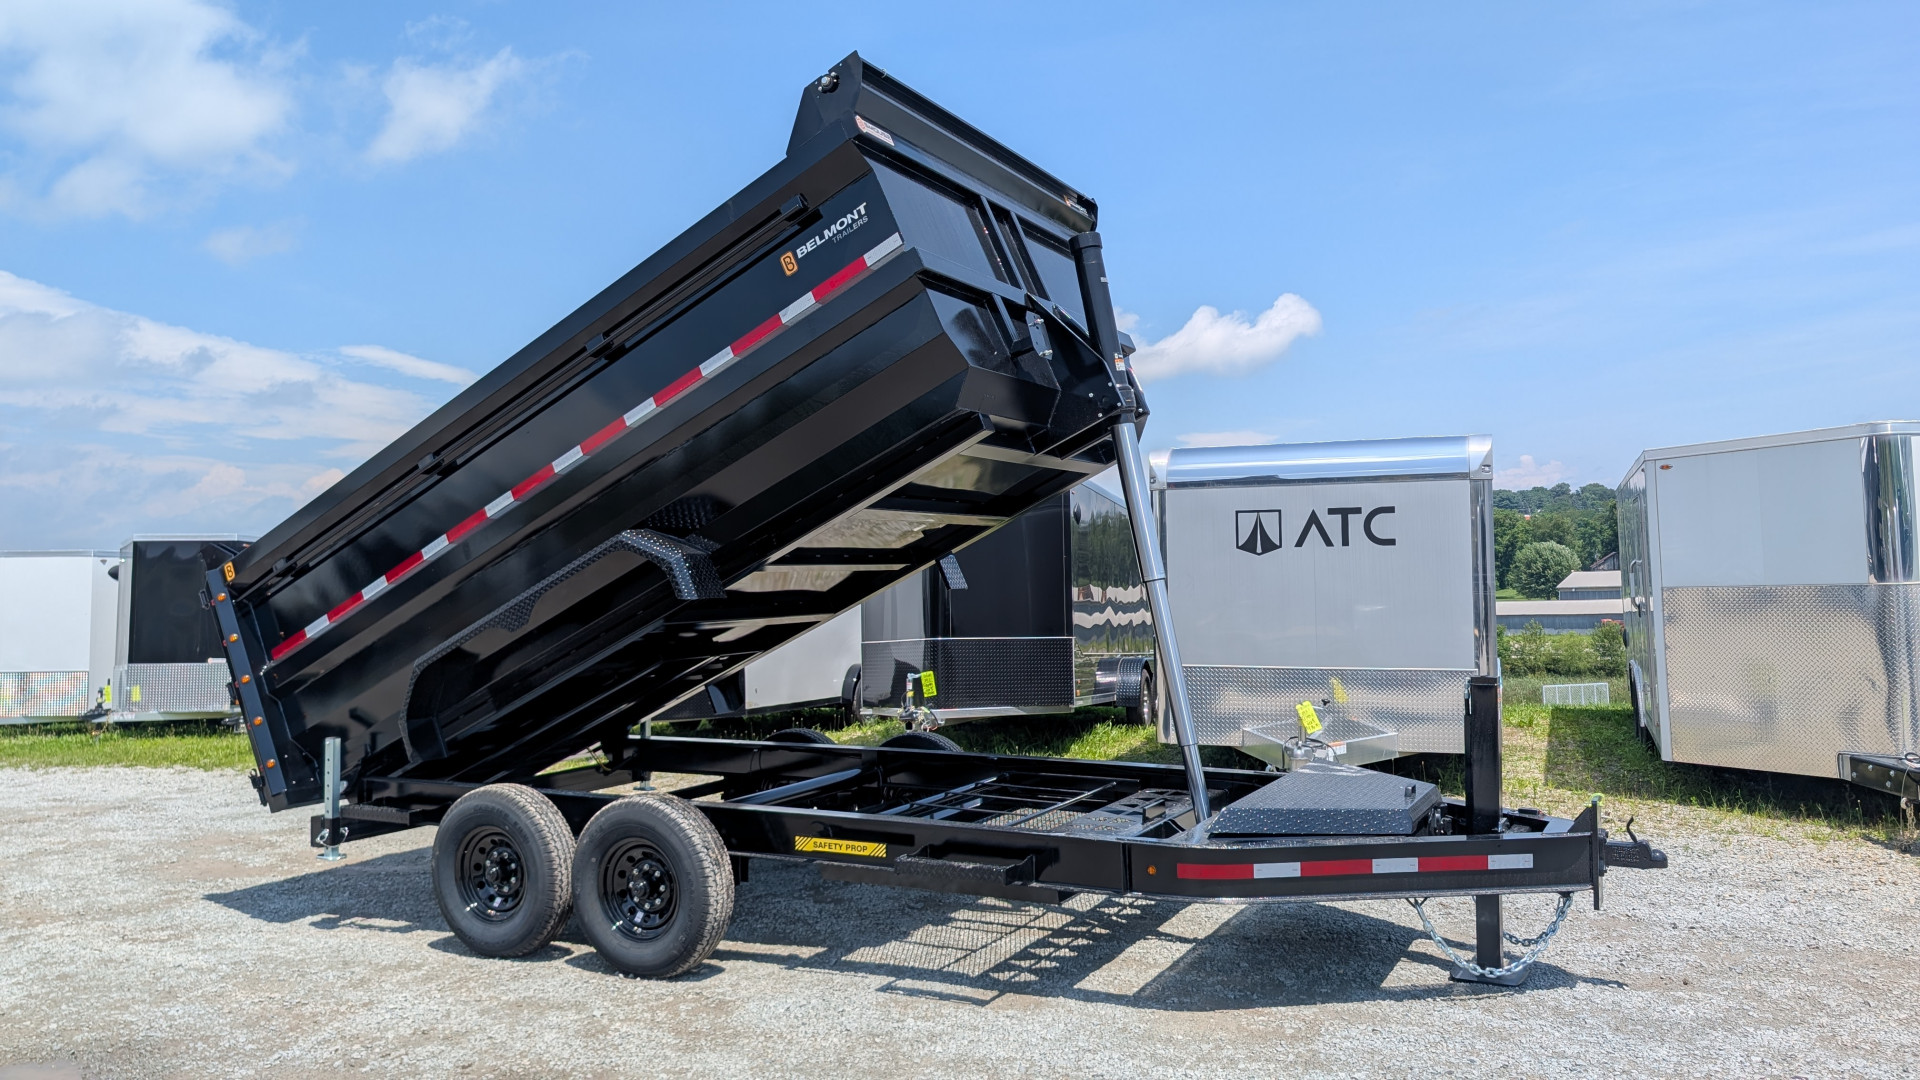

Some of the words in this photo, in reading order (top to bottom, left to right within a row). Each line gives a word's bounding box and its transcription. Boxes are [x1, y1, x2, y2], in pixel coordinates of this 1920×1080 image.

[796, 202, 867, 259] BELMONT
[832, 215, 869, 244] TRAILERS
[1294, 506, 1396, 547] ATC
[813, 841, 843, 851] SAFETY
[845, 844, 868, 853] PROP
